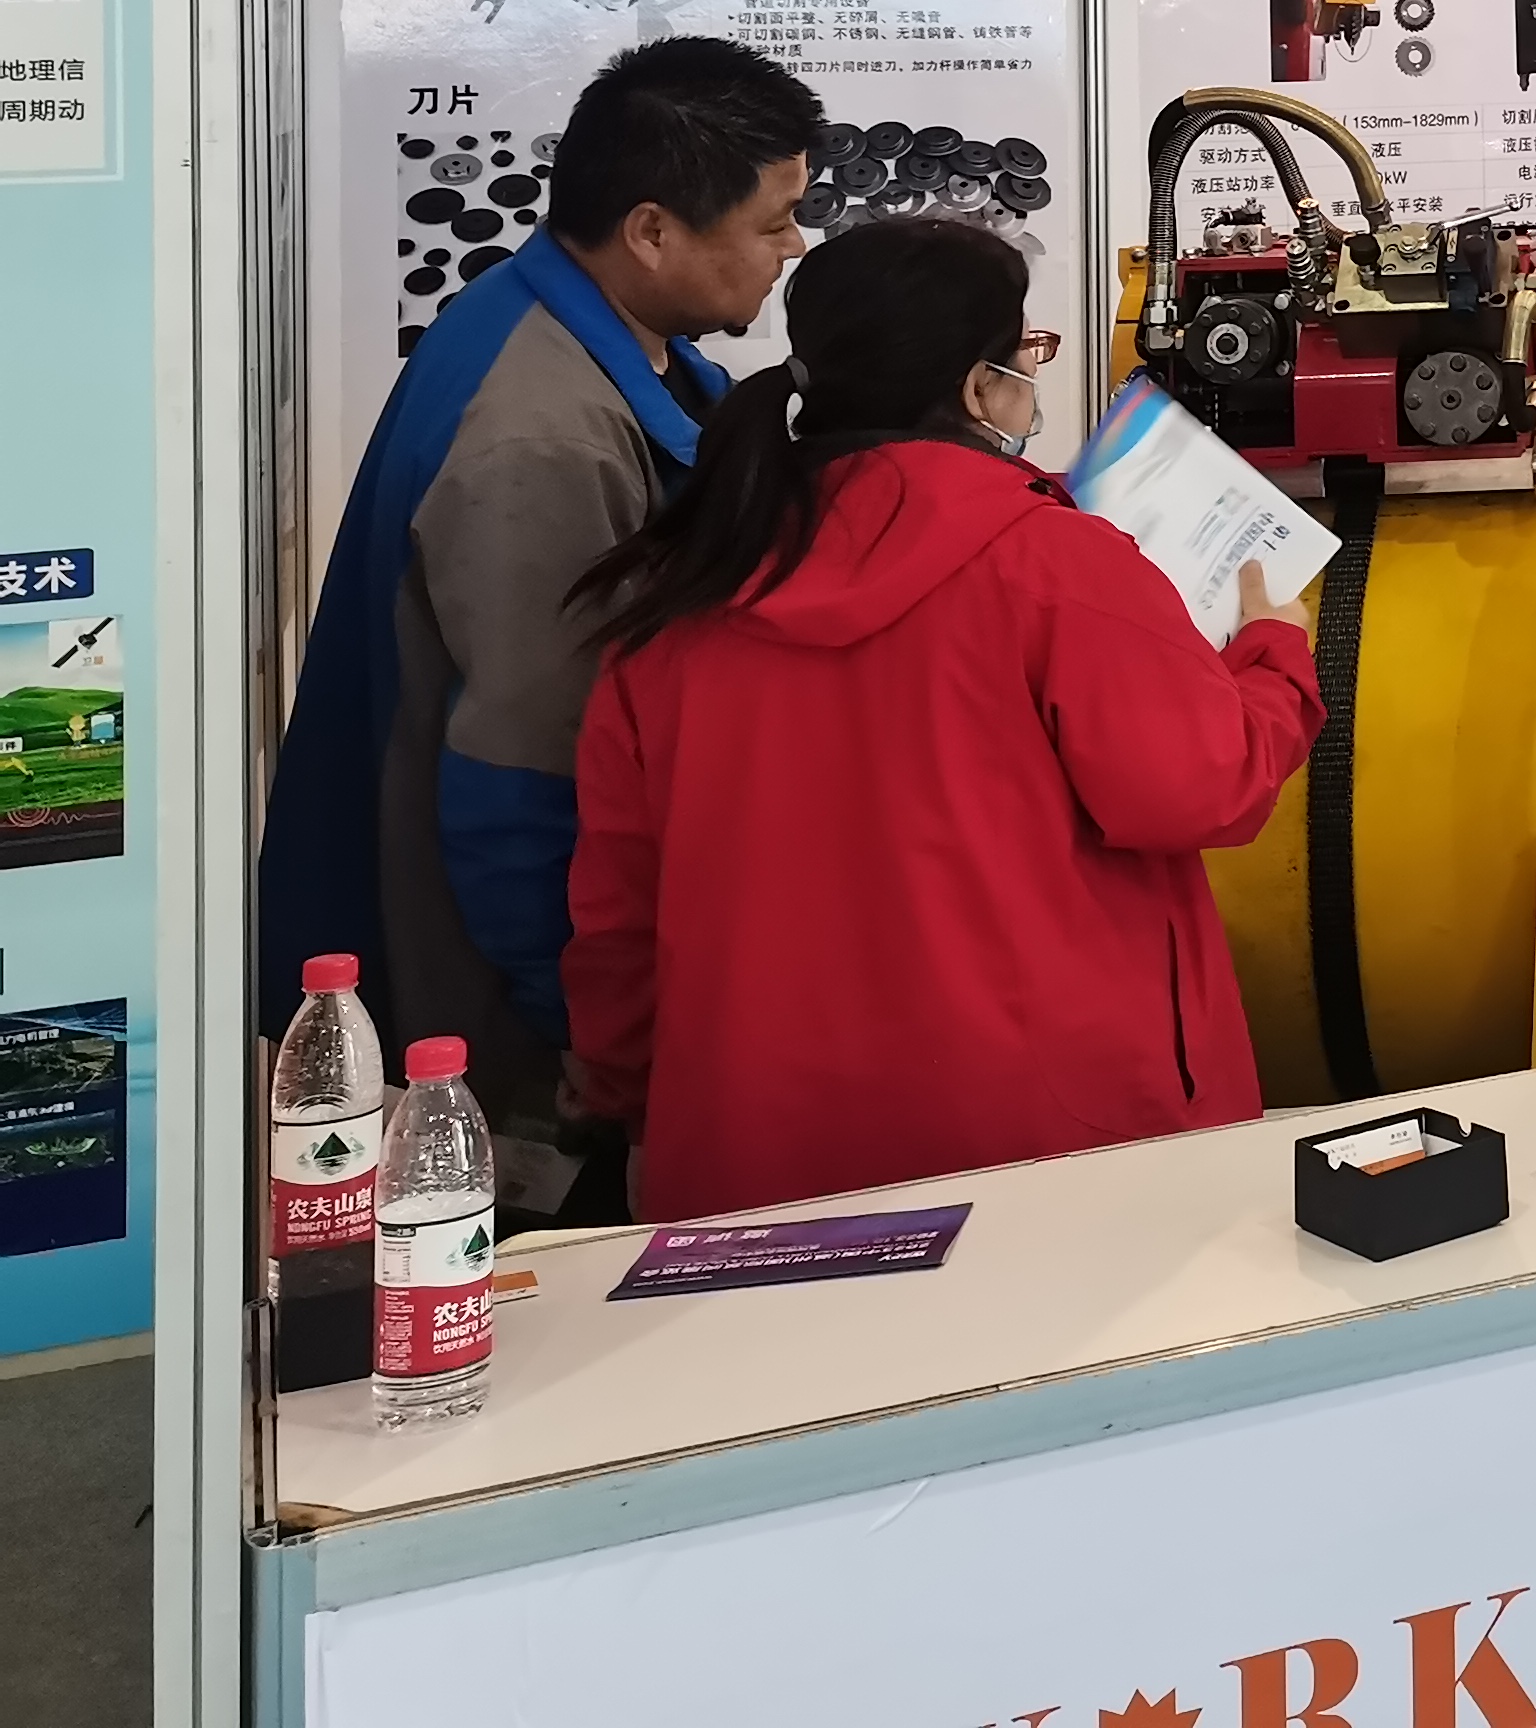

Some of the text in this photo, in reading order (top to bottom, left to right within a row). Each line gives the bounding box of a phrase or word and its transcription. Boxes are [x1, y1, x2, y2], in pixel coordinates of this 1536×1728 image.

[0, 59, 85, 82] 地理信
[0, 99, 85, 123] 周期动
[406, 85, 479, 117] 刀片
[1198, 147, 1267, 165] 驱动方式
[1371, 141, 1402, 158] 液压
[1191, 175, 1275, 194] 液压站功率
[286, 1188, 373, 1220] 农夫山泉
[287, 1210, 372, 1233] NONGFU SPRING
[433, 1288, 492, 1327] 农夫山
[433, 1321, 479, 1342] NONGFU
